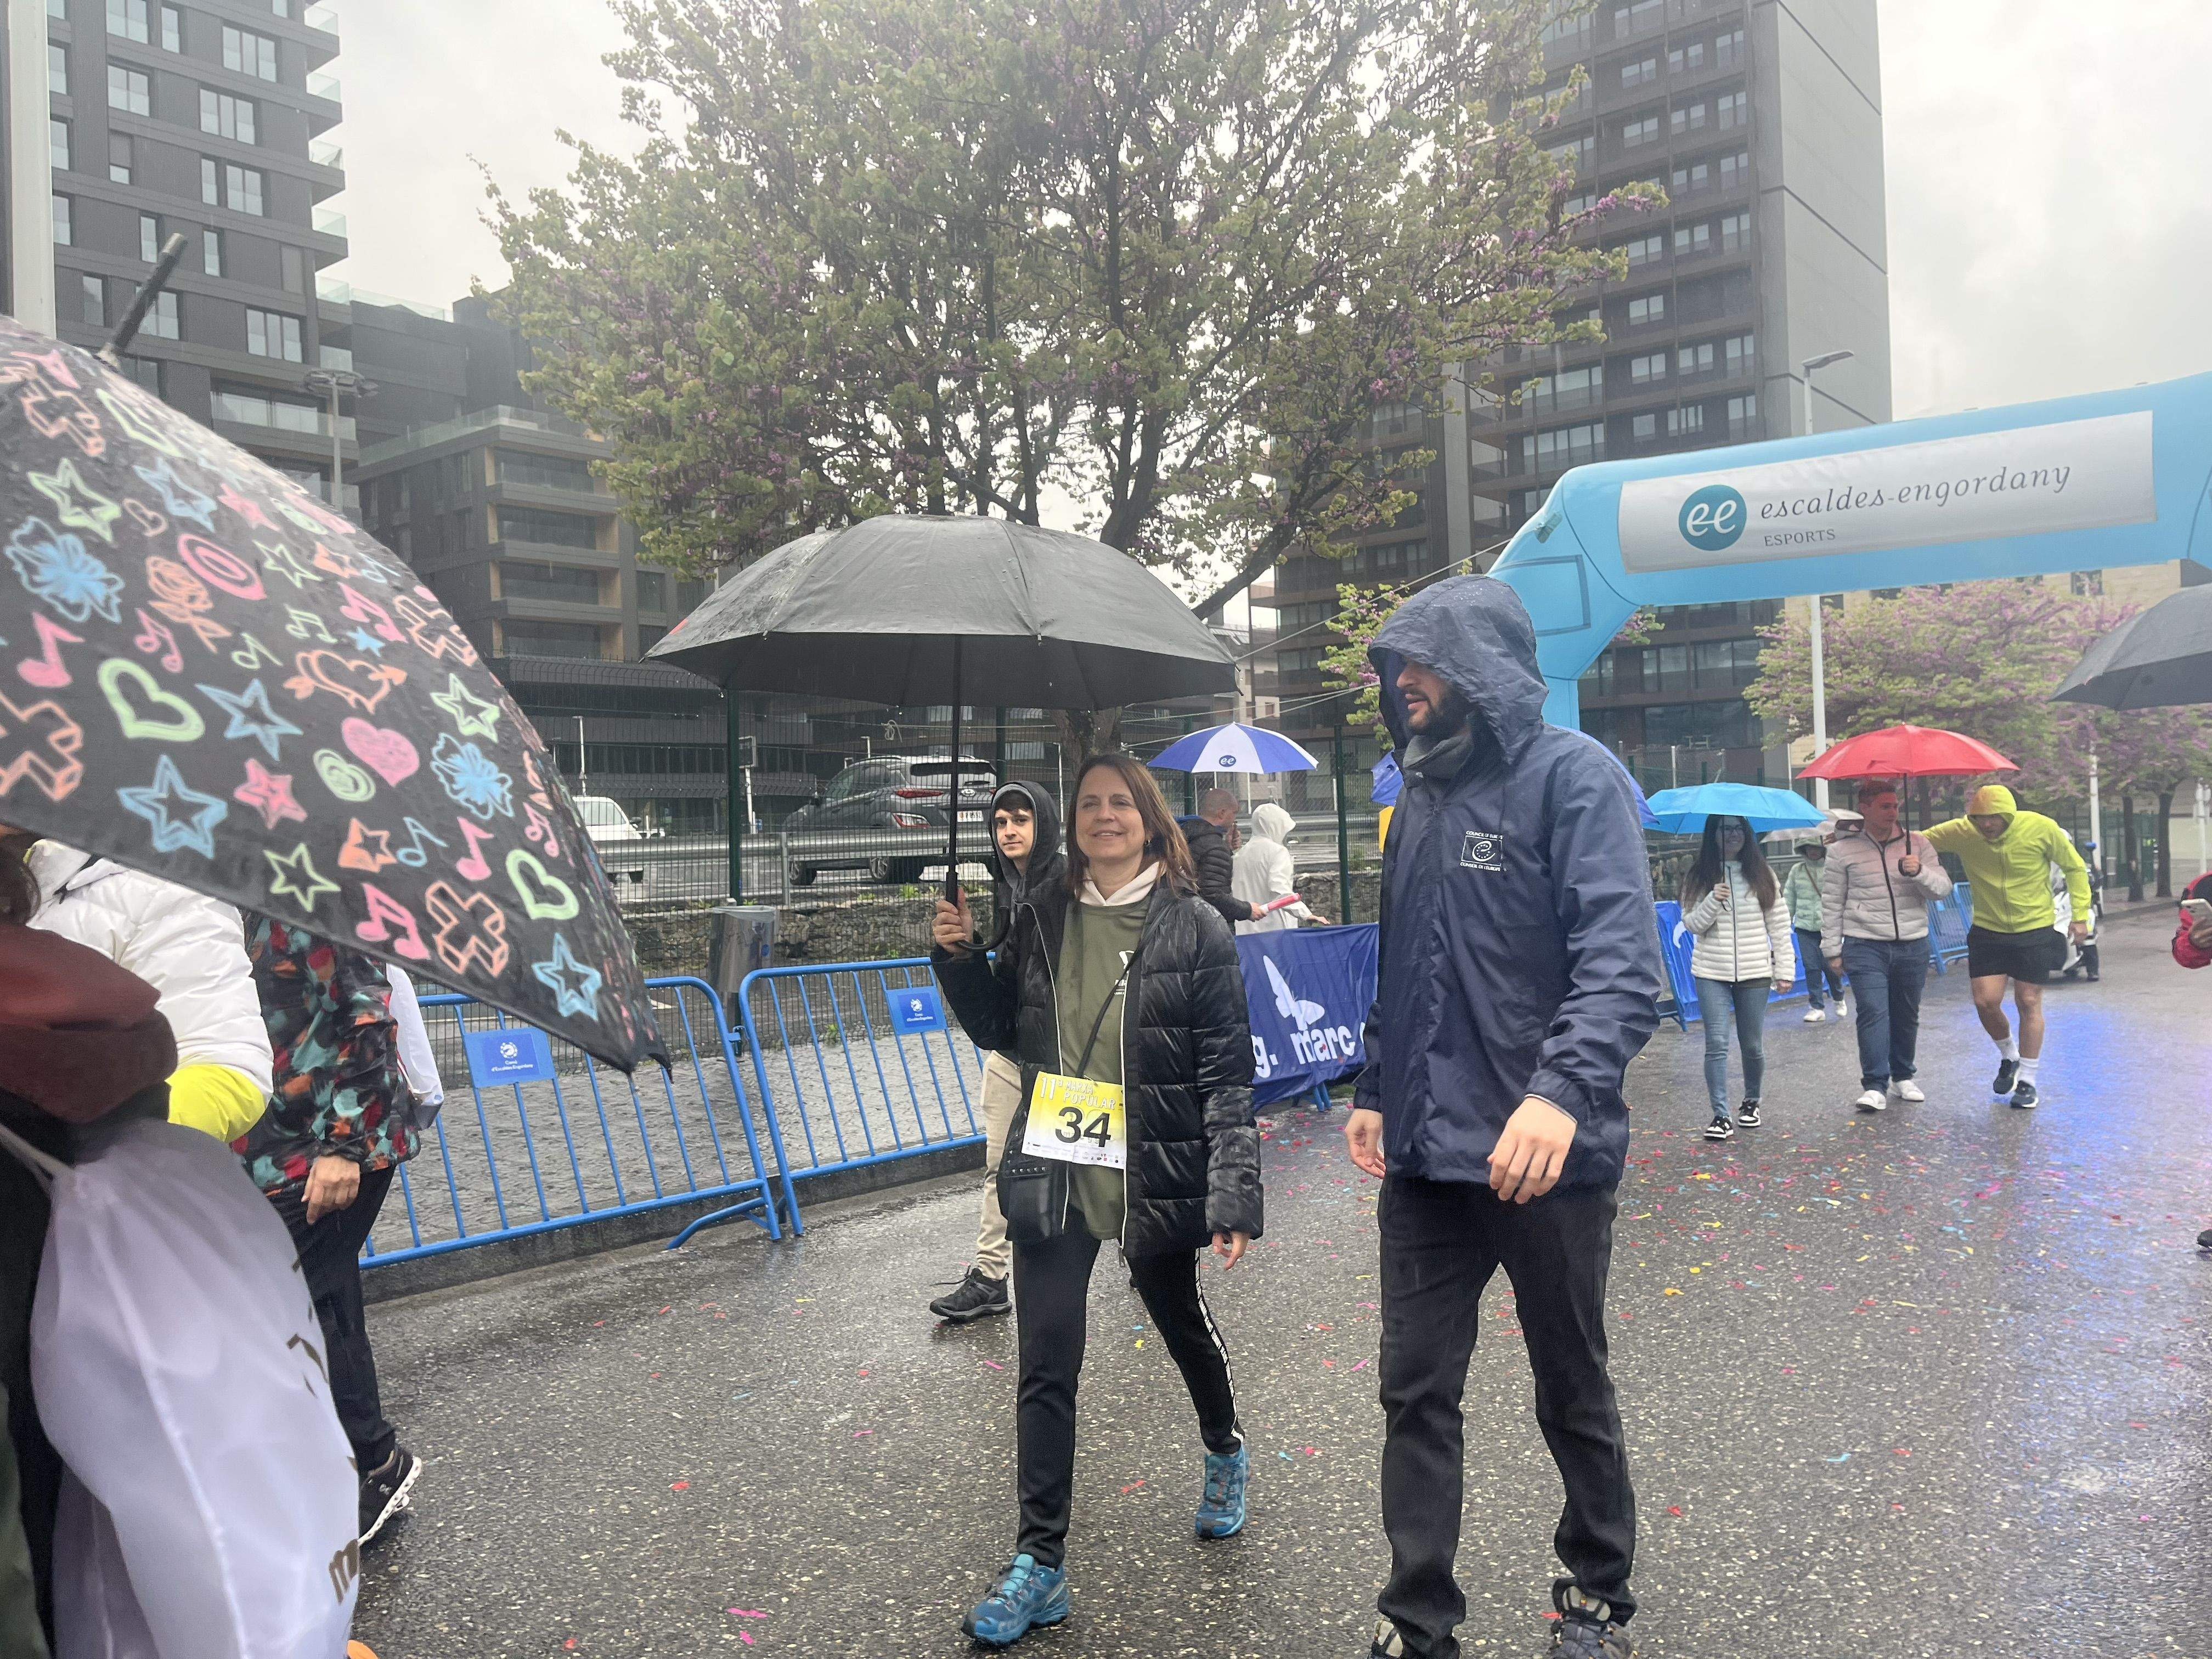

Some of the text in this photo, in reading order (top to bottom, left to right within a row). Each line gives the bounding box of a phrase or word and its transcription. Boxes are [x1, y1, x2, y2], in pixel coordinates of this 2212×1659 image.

[1761, 466, 2070, 519] escaldes-engordany
[1686, 499, 1737, 537] ee
[1764, 528, 1836, 546] ESPORTS
[1220, 757, 1235, 765] ee
[1290, 1025, 1355, 1064] marc
[1063, 1092, 1115, 1110] POPULAR
[1066, 1081, 1093, 1094] MARXA
[1055, 1106, 1111, 1148] 34
